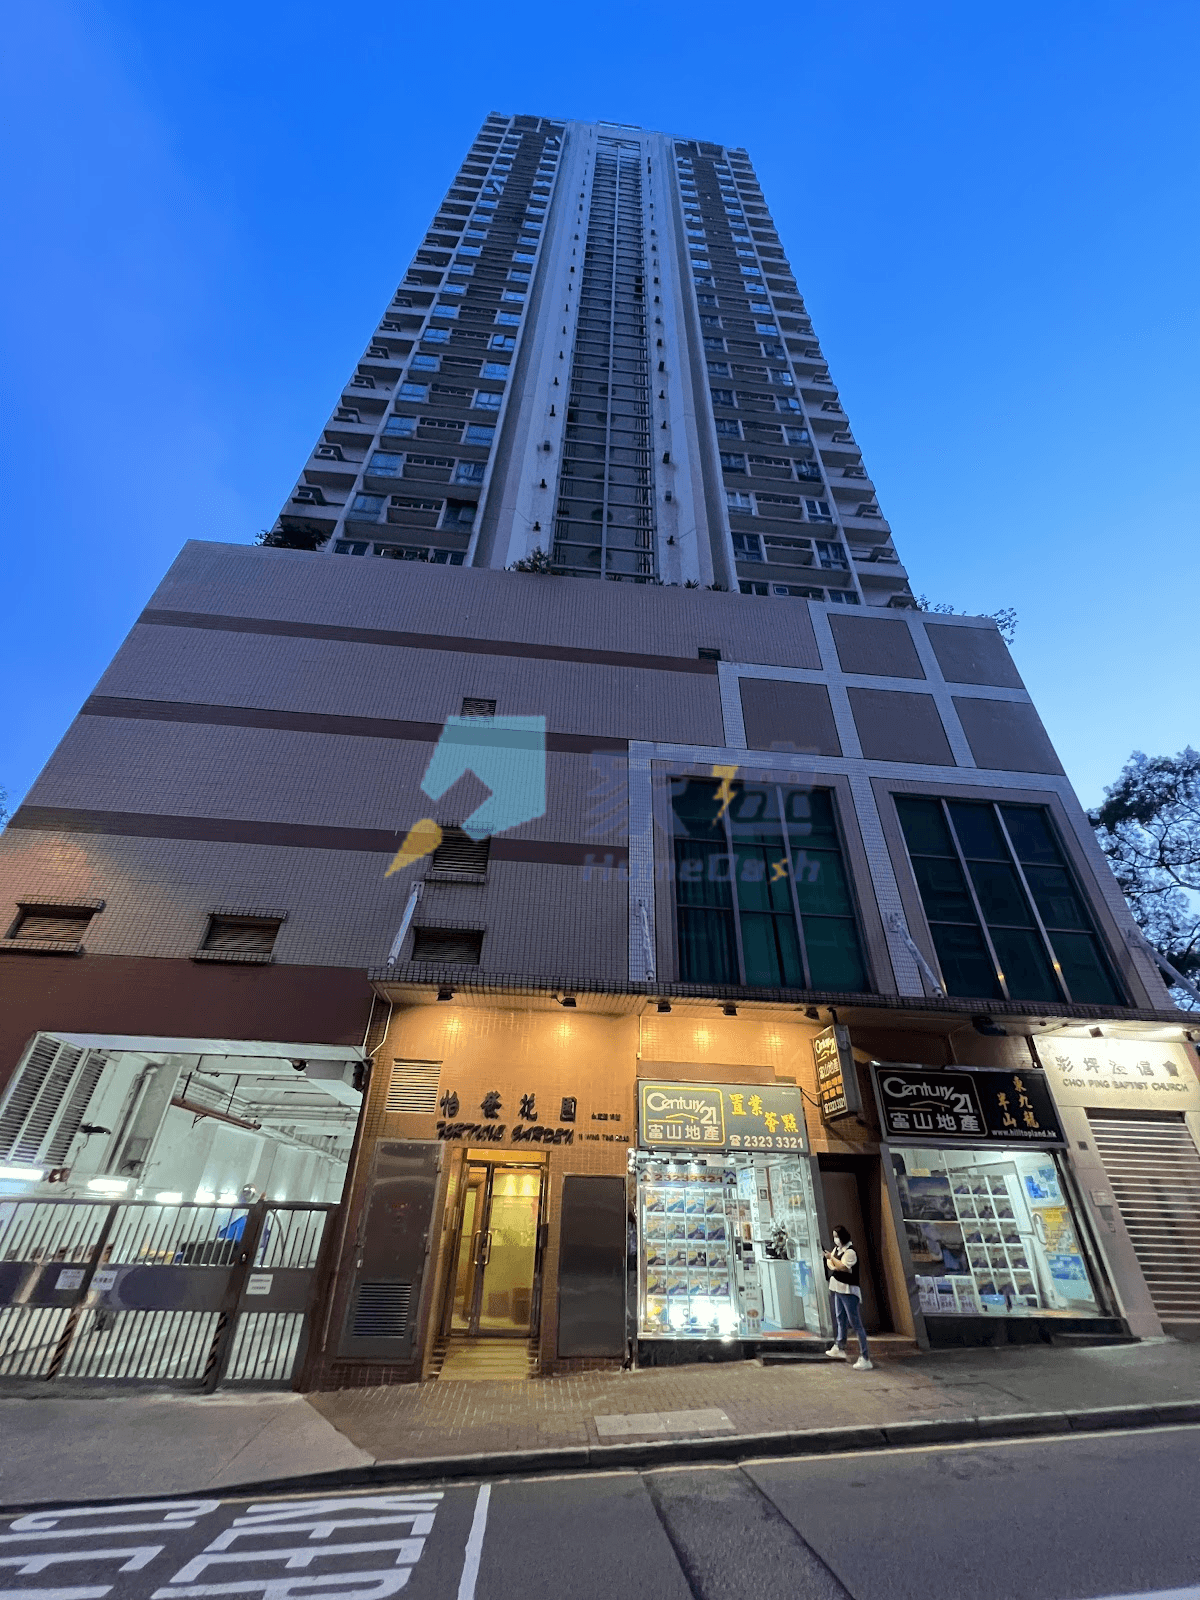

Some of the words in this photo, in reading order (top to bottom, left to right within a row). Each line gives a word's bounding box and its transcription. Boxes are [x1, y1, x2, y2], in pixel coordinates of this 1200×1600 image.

[882, 1076, 955, 1100] Century
[949, 1092, 974, 1113] 21
[1062, 1078, 1086, 1088] CHOI
[1088, 1079, 1111, 1088] PING
[1112, 1080, 1149, 1090] BAPTIST
[1150, 1082, 1190, 1092] CHURCH
[646, 1092, 706, 1113] Century
[699, 1106, 717, 1125] 21
[436, 1120, 507, 1142] FORTUNE
[510, 1124, 575, 1145] GARDEN
[648, 1124, 720, 1141] 富山地產
[889, 1112, 981, 1132] 富山地產
[743, 1135, 773, 1148] 2323
[775, 1136, 804, 1149] 3321
[991, 1129, 1058, 1138] www.hilltopland.hk
[0, 1499, 220, 1600] CLE
[150, 1491, 445, 1600] KEEP
